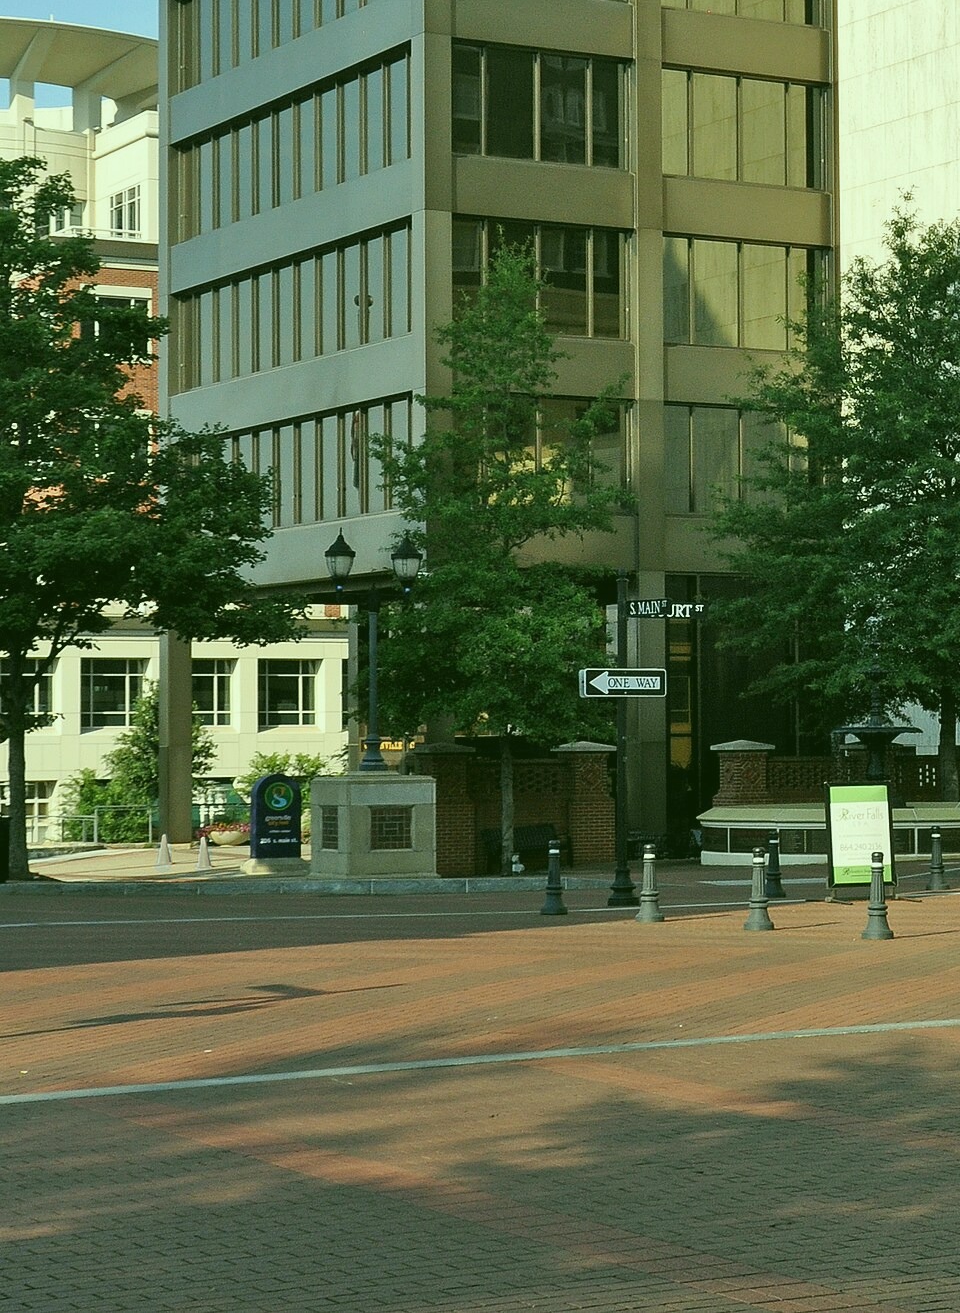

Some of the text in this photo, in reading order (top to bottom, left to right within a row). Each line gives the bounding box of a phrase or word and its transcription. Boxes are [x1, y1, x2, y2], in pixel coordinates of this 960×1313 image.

[630, 600, 668, 615] S. MAIN ST
[695, 604, 704, 612] ST
[608, 678, 657, 688] ONE WAY
[836, 807, 883, 822] River Falls
